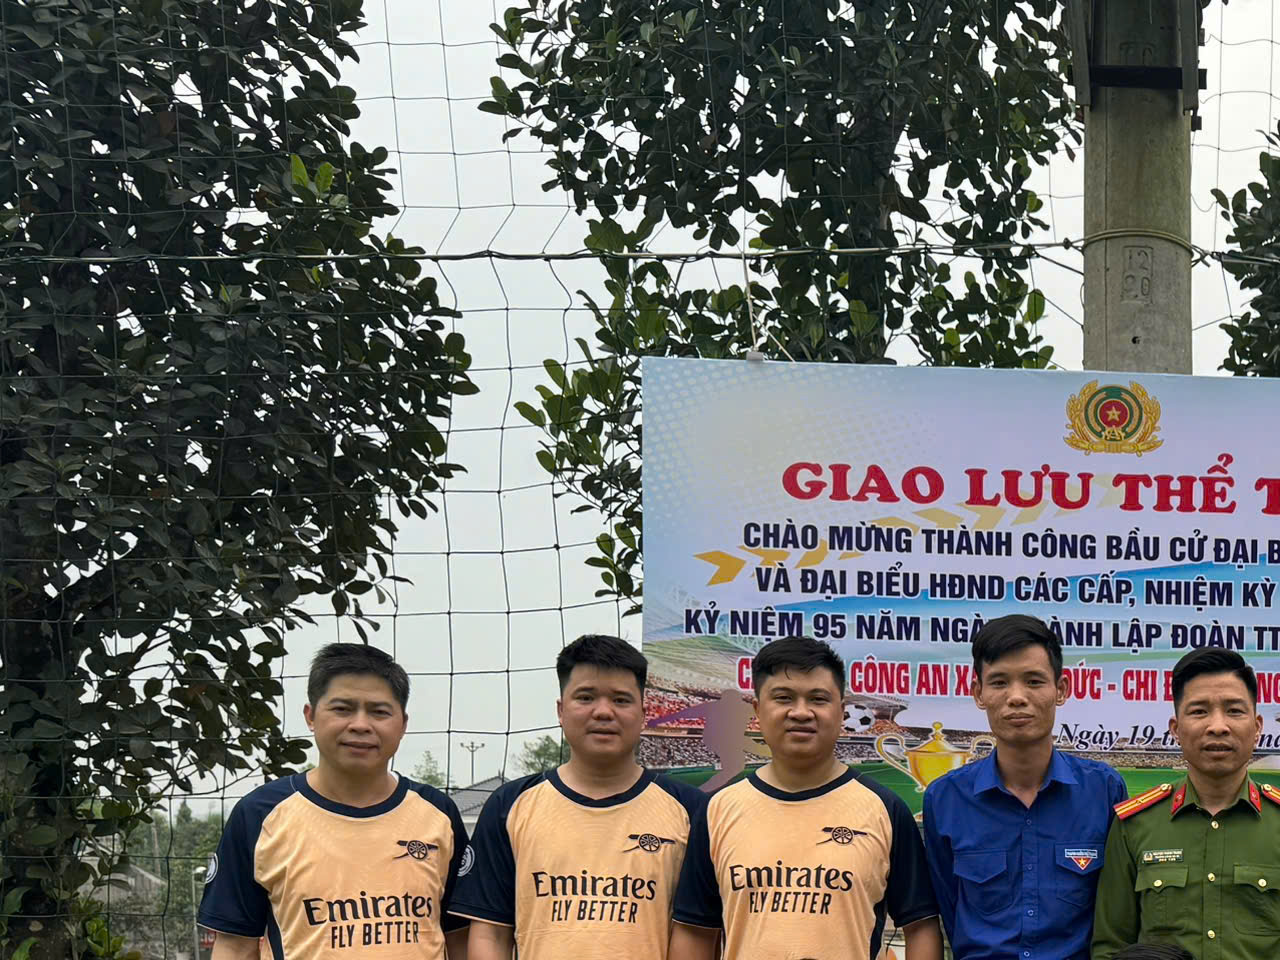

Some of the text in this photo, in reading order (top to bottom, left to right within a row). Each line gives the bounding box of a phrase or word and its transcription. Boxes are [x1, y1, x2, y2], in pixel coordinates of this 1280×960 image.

[782, 462, 944, 504] GIAO
[964, 464, 1094, 510] LƯU
[1112, 453, 1236, 514] THỂ
[743, 518, 818, 550] CHÀO
[829, 520, 913, 555] MỪNG
[922, 524, 1012, 557] THÀNH
[1022, 528, 1096, 560] CÔNG
[1106, 526, 1160, 562] BẦU
[1169, 529, 1208, 563] CỬ
[1213, 538, 1260, 570] ĐẠI
[755, 562, 790, 593] VÀ
[800, 568, 847, 600] ĐẠI
[857, 561, 921, 599] BIỂU
[929, 573, 1002, 600] HĐND
[1014, 571, 1069, 603] CÁC
[1078, 570, 1136, 608] CẤP,
[1144, 576, 1233, 611] NHIỆM
[1242, 576, 1274, 608] KỲ
[684, 600, 720, 636] KỶ
[730, 611, 803, 642] NIỆM
[812, 612, 847, 638] 95
[856, 609, 921, 641] NĂM
[930, 613, 985, 643] NGÀ
[1050, 615, 1103, 647] ÀNH
[1111, 617, 1162, 653] LẬP
[1171, 620, 1245, 650] ĐOÀN
[851, 656, 909, 694] CÔNG
[917, 663, 949, 695] AN
[955, 664, 977, 696] X
[1123, 670, 1157, 701] CHI
[1056, 723, 1120, 751] Ngày
[1128, 724, 1156, 746] 19
[532, 869, 657, 901] Emirates
[729, 860, 854, 892] Emirates
[303, 890, 433, 926] Emirates
[552, 900, 638, 924] FLY BETTER
[749, 891, 832, 915] FLY BETTER
[331, 921, 420, 949] FLY BETTER
